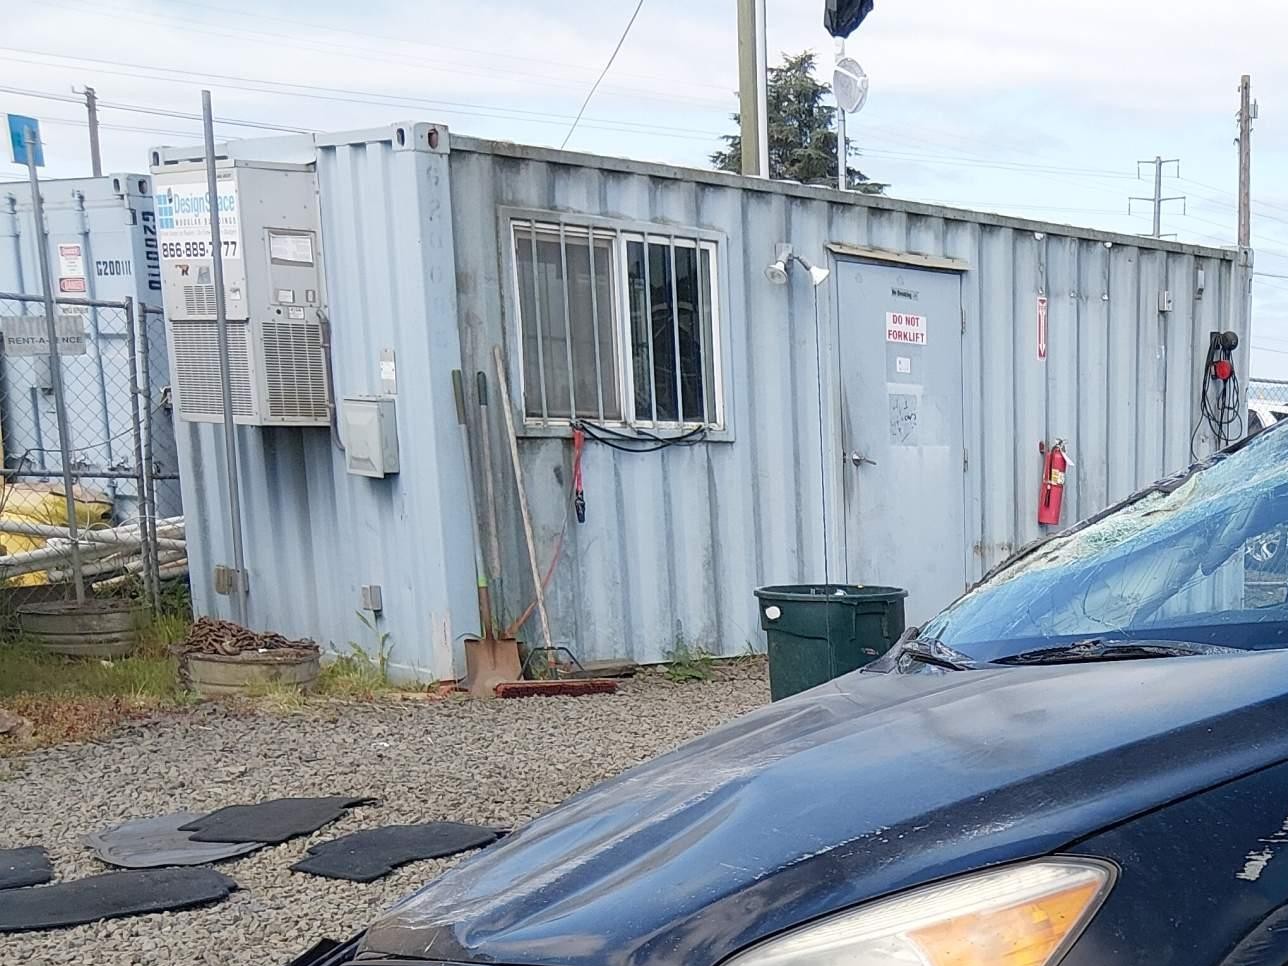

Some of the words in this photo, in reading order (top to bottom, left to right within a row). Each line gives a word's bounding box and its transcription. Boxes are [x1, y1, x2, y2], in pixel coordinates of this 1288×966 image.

[174, 192, 235, 217] DesignSace
[892, 314, 903, 325] DO
[905, 315, 920, 327] NOT
[8, 336, 83, 345] RENT-A-NCE
[888, 329, 925, 343] FORKLIFT
